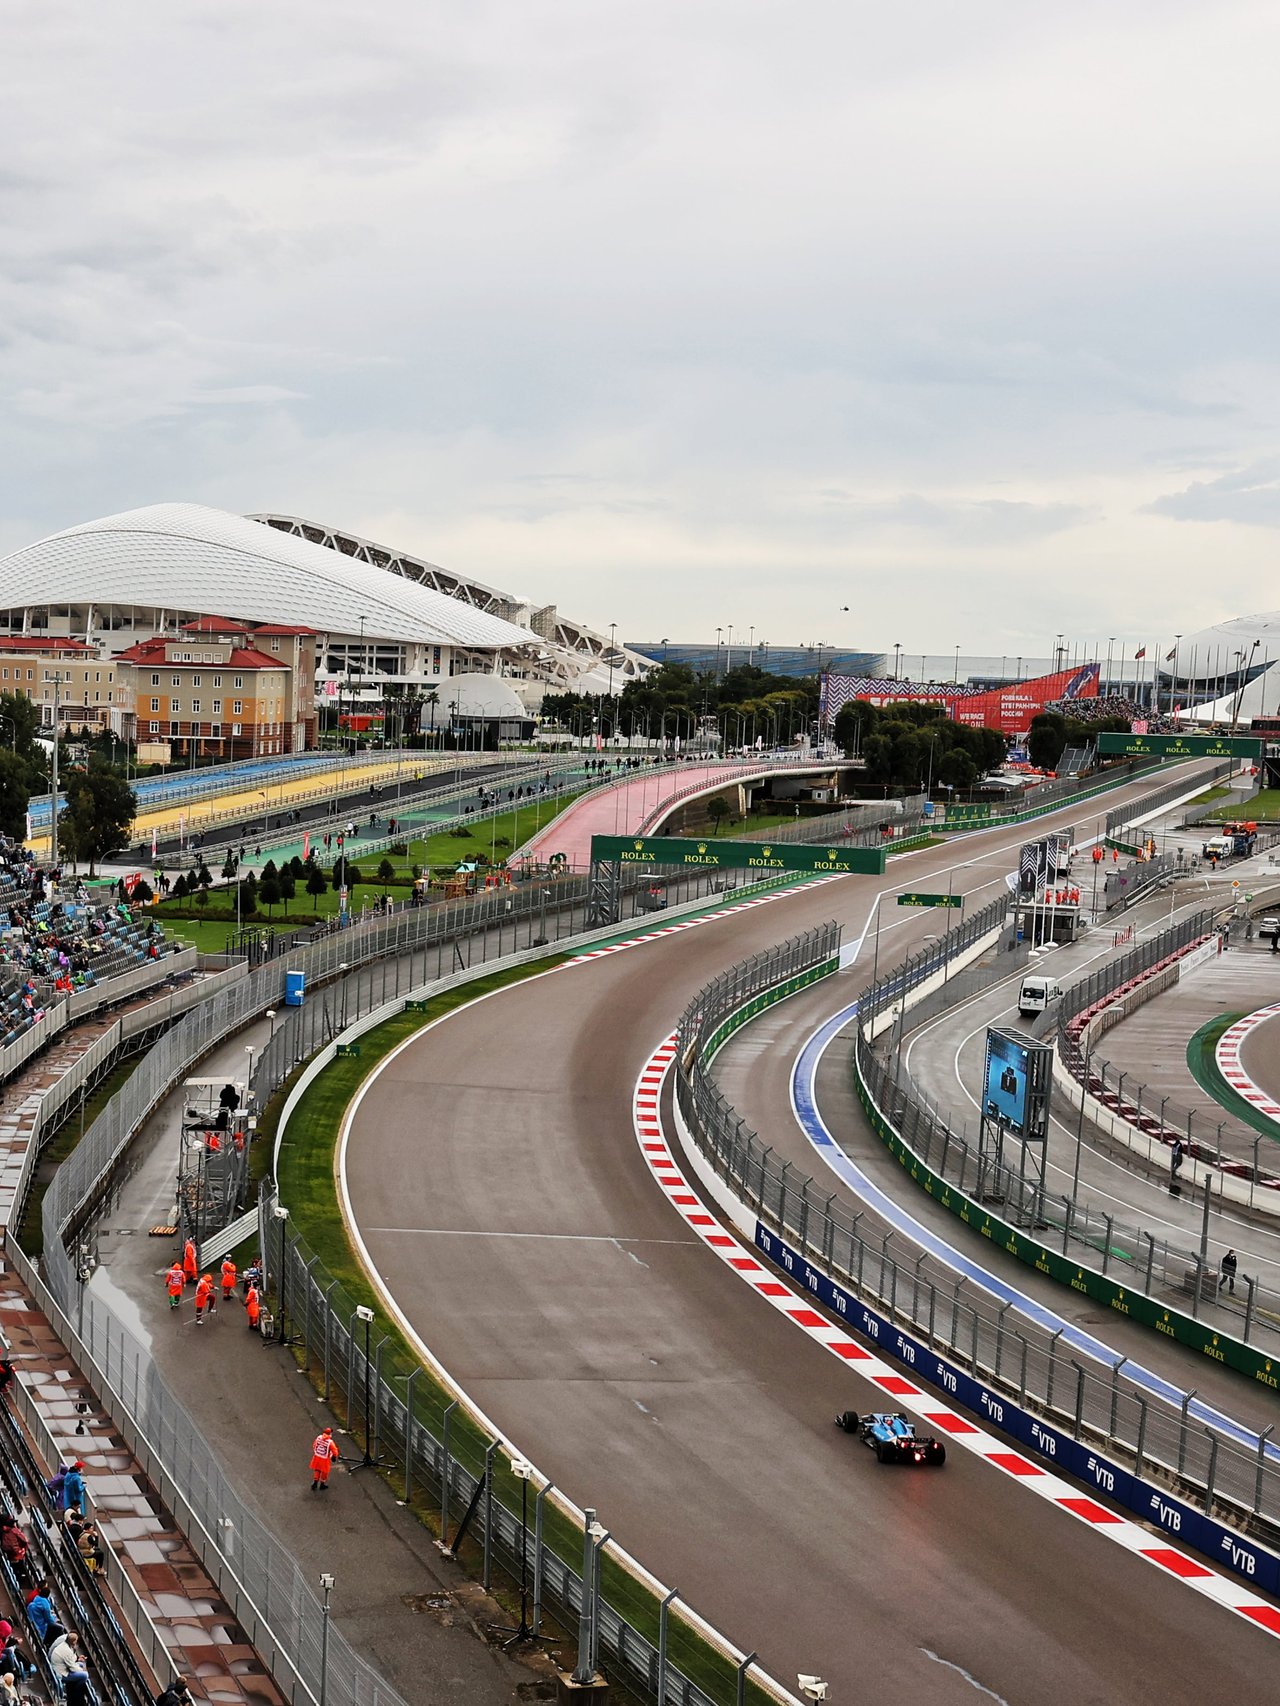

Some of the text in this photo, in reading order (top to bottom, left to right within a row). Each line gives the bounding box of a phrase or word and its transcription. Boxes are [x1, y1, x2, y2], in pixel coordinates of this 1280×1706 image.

[970, 720, 985, 728] ONE
[621, 851, 850, 871] ROLEX ROLEX ROLEX ROLEX
[1035, 1260, 1050, 1275] ROLEX
[1070, 1278, 1087, 1294] ROLEX
[1111, 1298, 1129, 1315] ROLEX
[1155, 1320, 1175, 1337] ROLEX
[1203, 1344, 1224, 1362] ROLEX
[1255, 1370, 1278, 1388] ROLEX
[867, 1317, 879, 1338] VTB
[902, 1342, 915, 1364] VTB
[943, 1369, 957, 1392] VTB
[987, 1399, 1004, 1423] VTB
[1038, 1430, 1056, 1456] VTB
[1095, 1465, 1115, 1492] VTB
[1160, 1503, 1181, 1531] VTB
[1232, 1544, 1256, 1575] VTB
